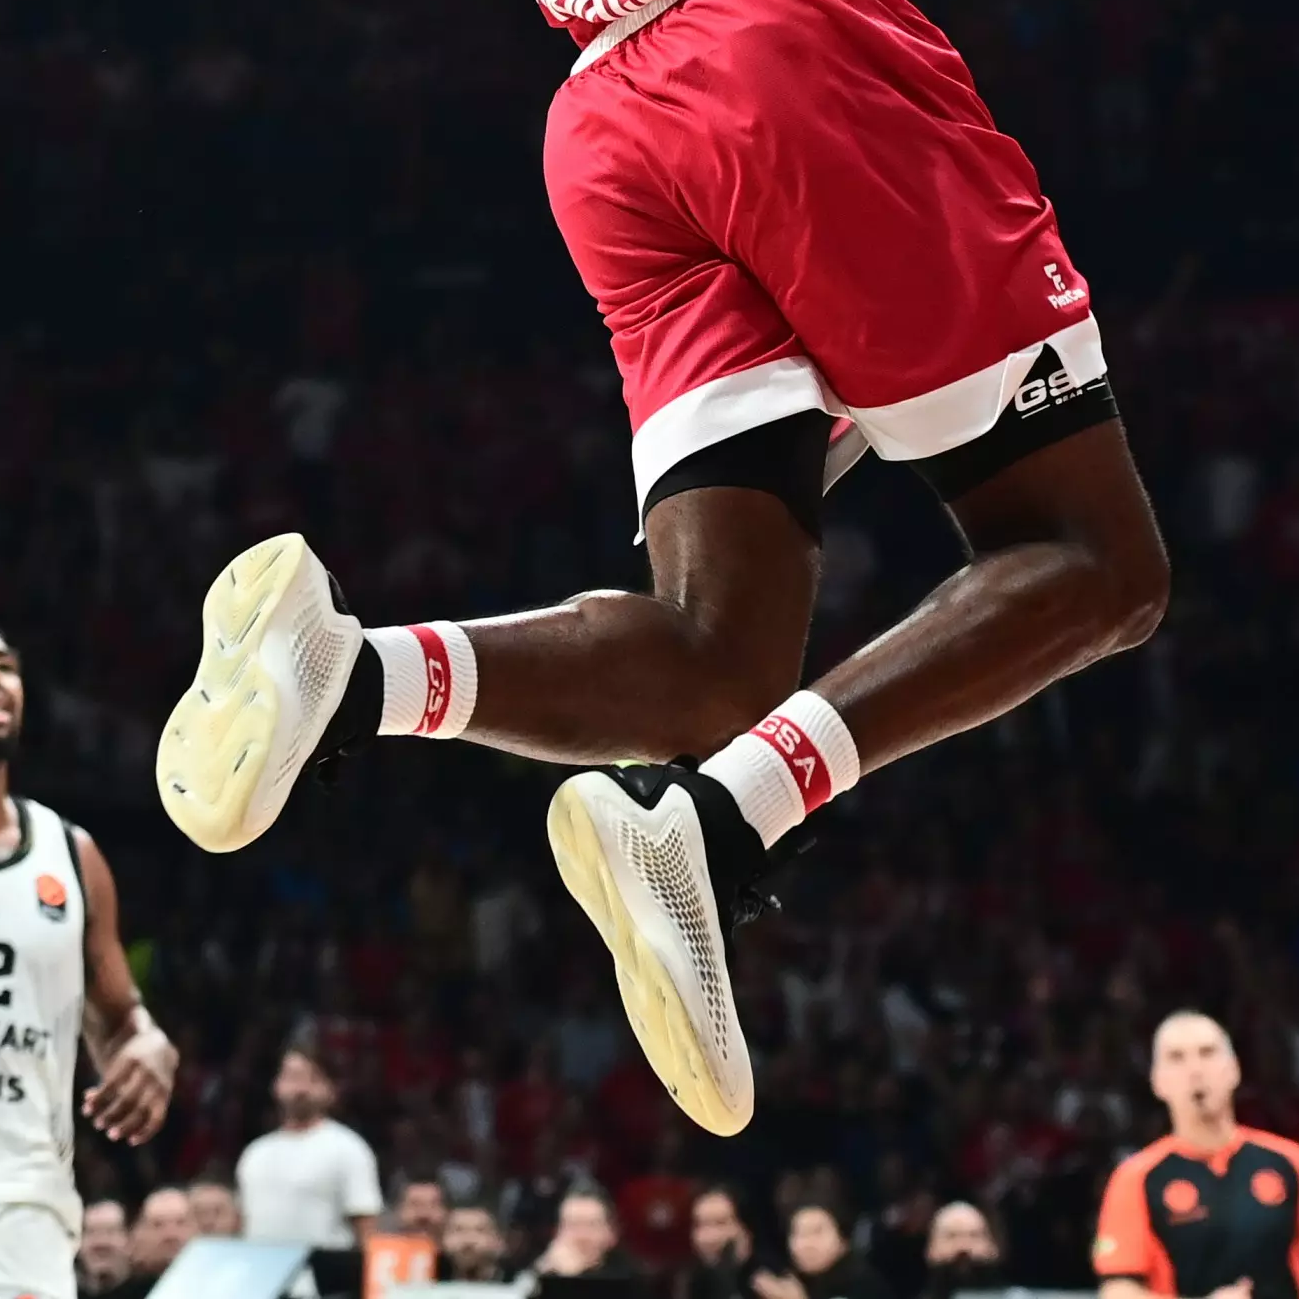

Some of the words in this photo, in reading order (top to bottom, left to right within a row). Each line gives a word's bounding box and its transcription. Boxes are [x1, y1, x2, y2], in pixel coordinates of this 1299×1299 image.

[1014, 368, 1076, 412] GS
[1055, 388, 1083, 405] GEAR
[756, 716, 816, 789] GSA
